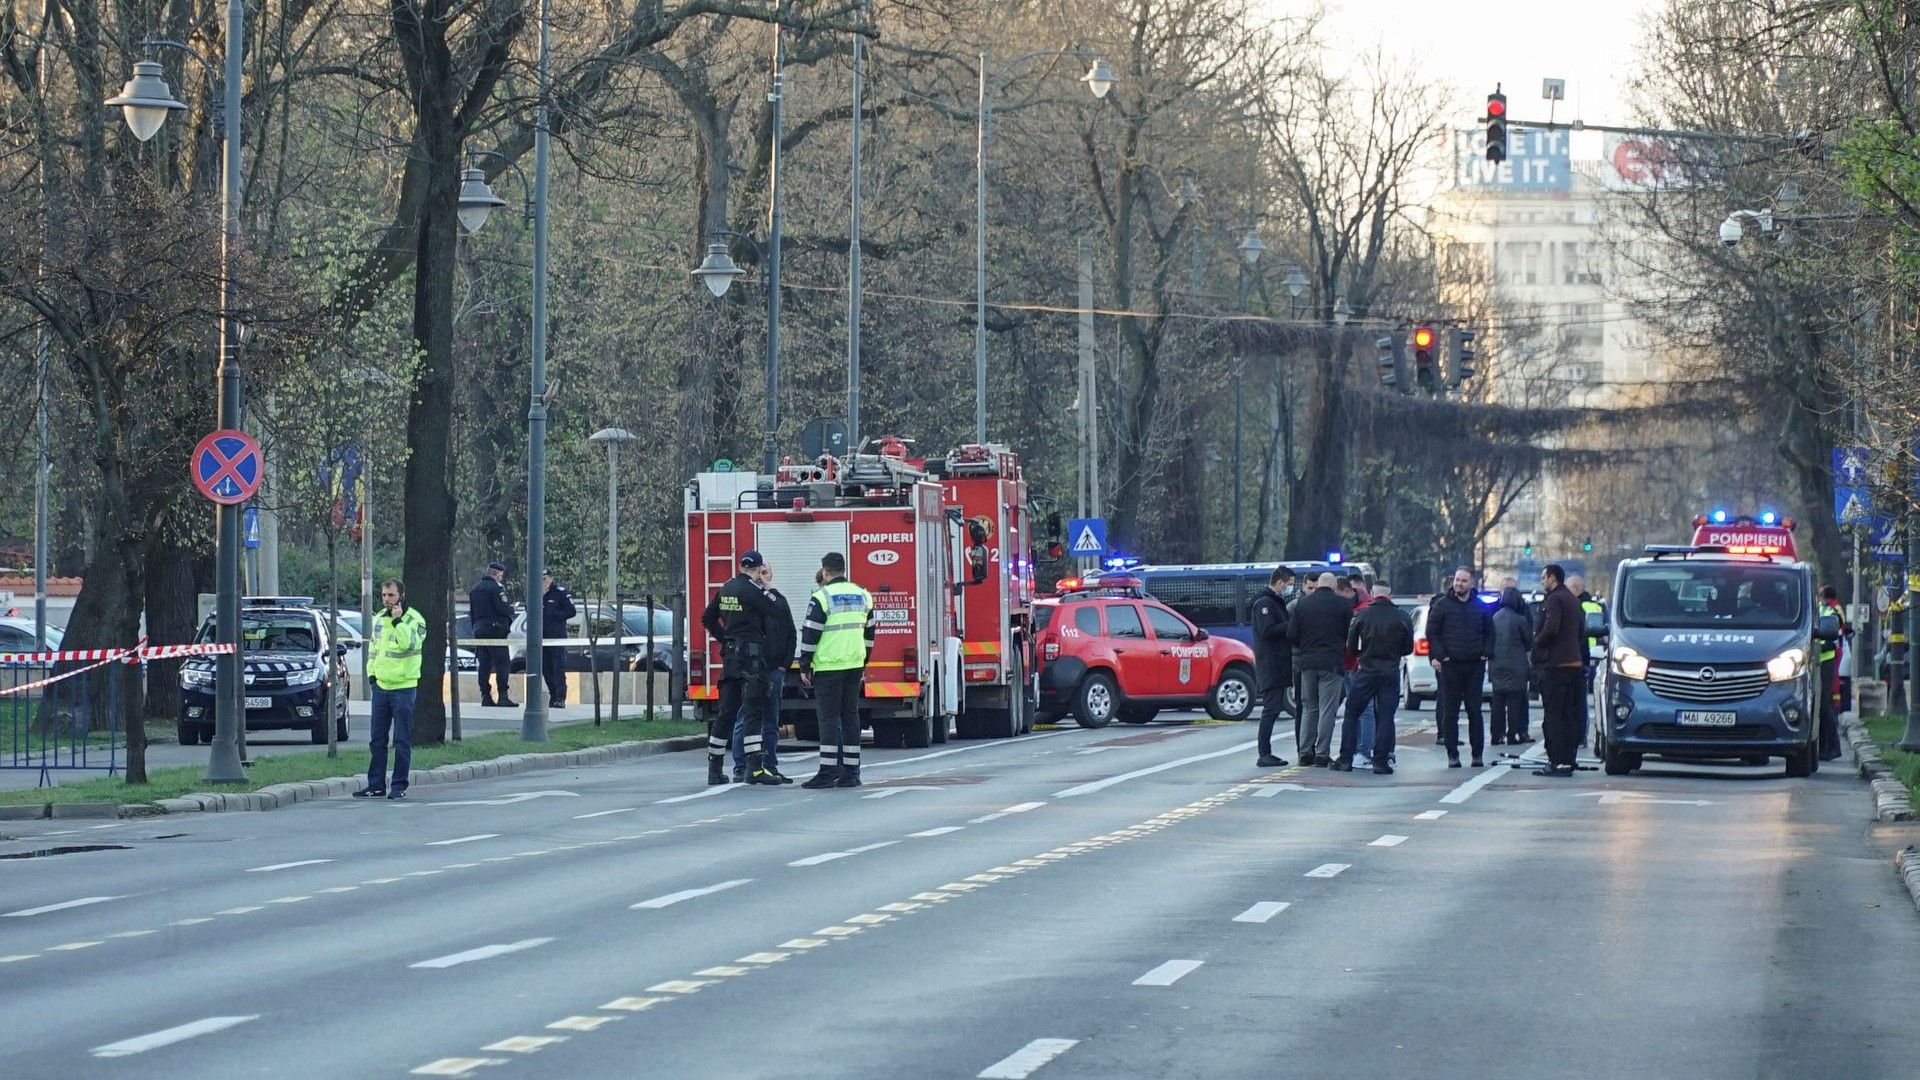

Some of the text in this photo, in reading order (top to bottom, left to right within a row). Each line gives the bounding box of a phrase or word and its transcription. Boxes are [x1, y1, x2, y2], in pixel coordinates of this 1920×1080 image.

[1457, 130, 1525, 156] LOE
[1459, 158, 1556, 184] LIVE IT.
[852, 532, 914, 544] POMPIERI
[873, 553, 894, 561] 112
[908, 596, 916, 610] 1
[1065, 628, 1080, 638] 112
[1683, 713, 1734, 724] MAI 49266
